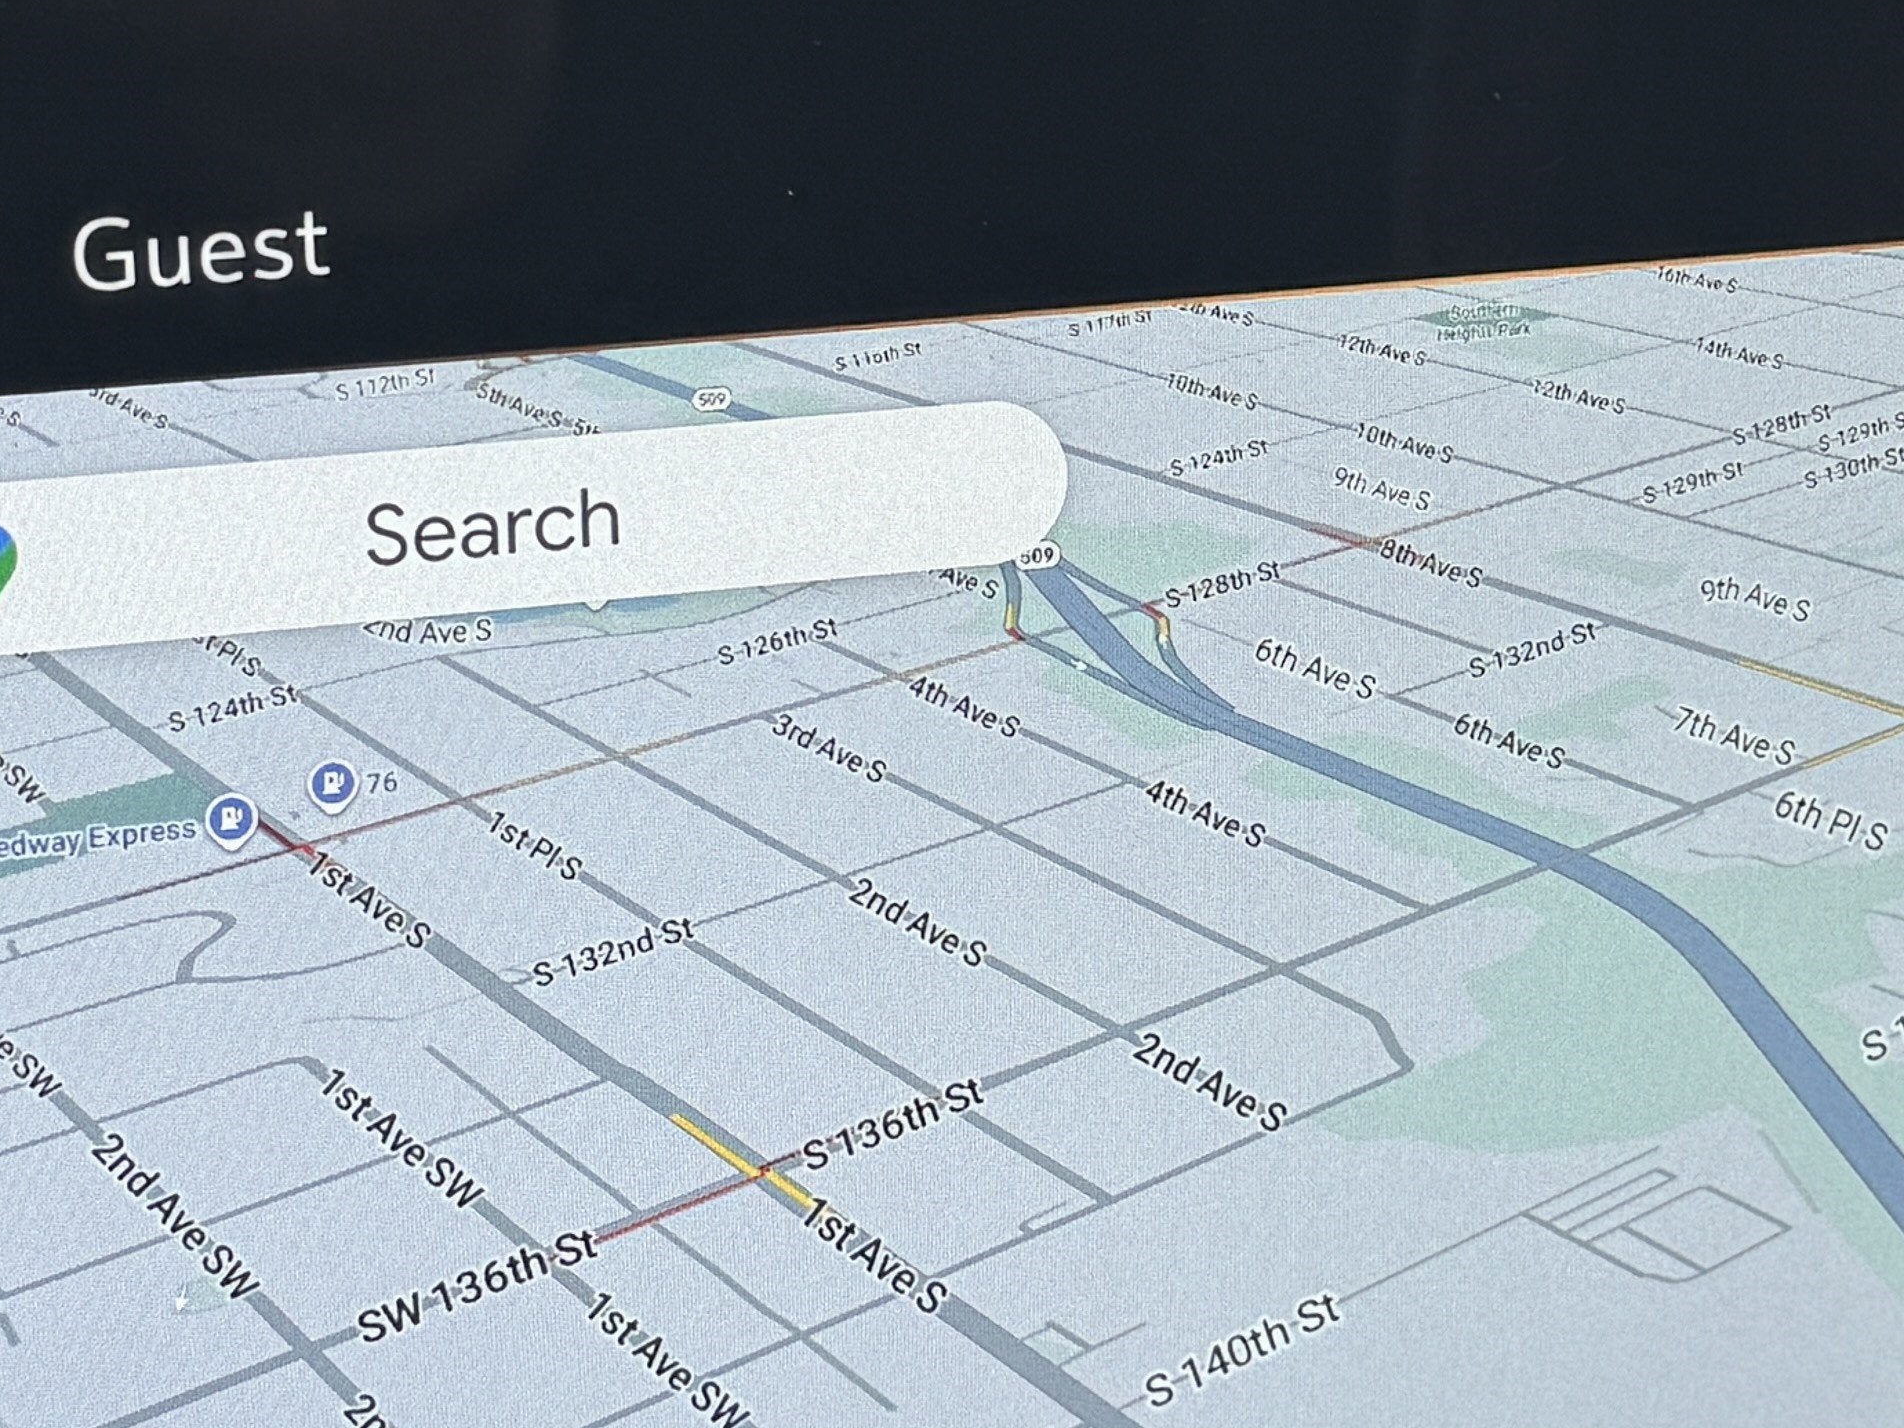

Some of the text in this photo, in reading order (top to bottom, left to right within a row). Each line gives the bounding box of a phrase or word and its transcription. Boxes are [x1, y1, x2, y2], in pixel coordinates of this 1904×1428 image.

[74, 210, 331, 292] Guest
[698, 391, 726, 408] 509
[367, 488, 619, 566] Search
[1165, 563, 1280, 608] S 128th St
[1701, 575, 1811, 622] 9th Ave S
[718, 618, 837, 665] S 126th St
[1255, 639, 1376, 700] 6th Ave S
[1469, 621, 1596, 677] S 132nd St
[169, 685, 297, 732] S 124th St
[909, 676, 1020, 739] 4th Ave S
[1674, 706, 1796, 765] 7th Ave S
[772, 714, 886, 783] 3rd Ave S
[4, 765, 46, 803] SW
[369, 774, 397, 793] 76
[91, 819, 196, 854] Express
[491, 811, 581, 881] 1st Pl S
[1775, 792, 1889, 852] 6th Pl S
[309, 853, 431, 948] 1st Ave S
[850, 879, 988, 967] 2nd Ave S
[534, 918, 694, 987] S 132nd St
[12, 1051, 62, 1098] SW
[322, 1069, 484, 1209] 1st Ave SW
[803, 1077, 983, 1170] S 136th St
[358, 1230, 598, 1344] SW 136th St
[804, 1198, 947, 1314] 1st Ave S
[1146, 1295, 1341, 1408] S 140th St
